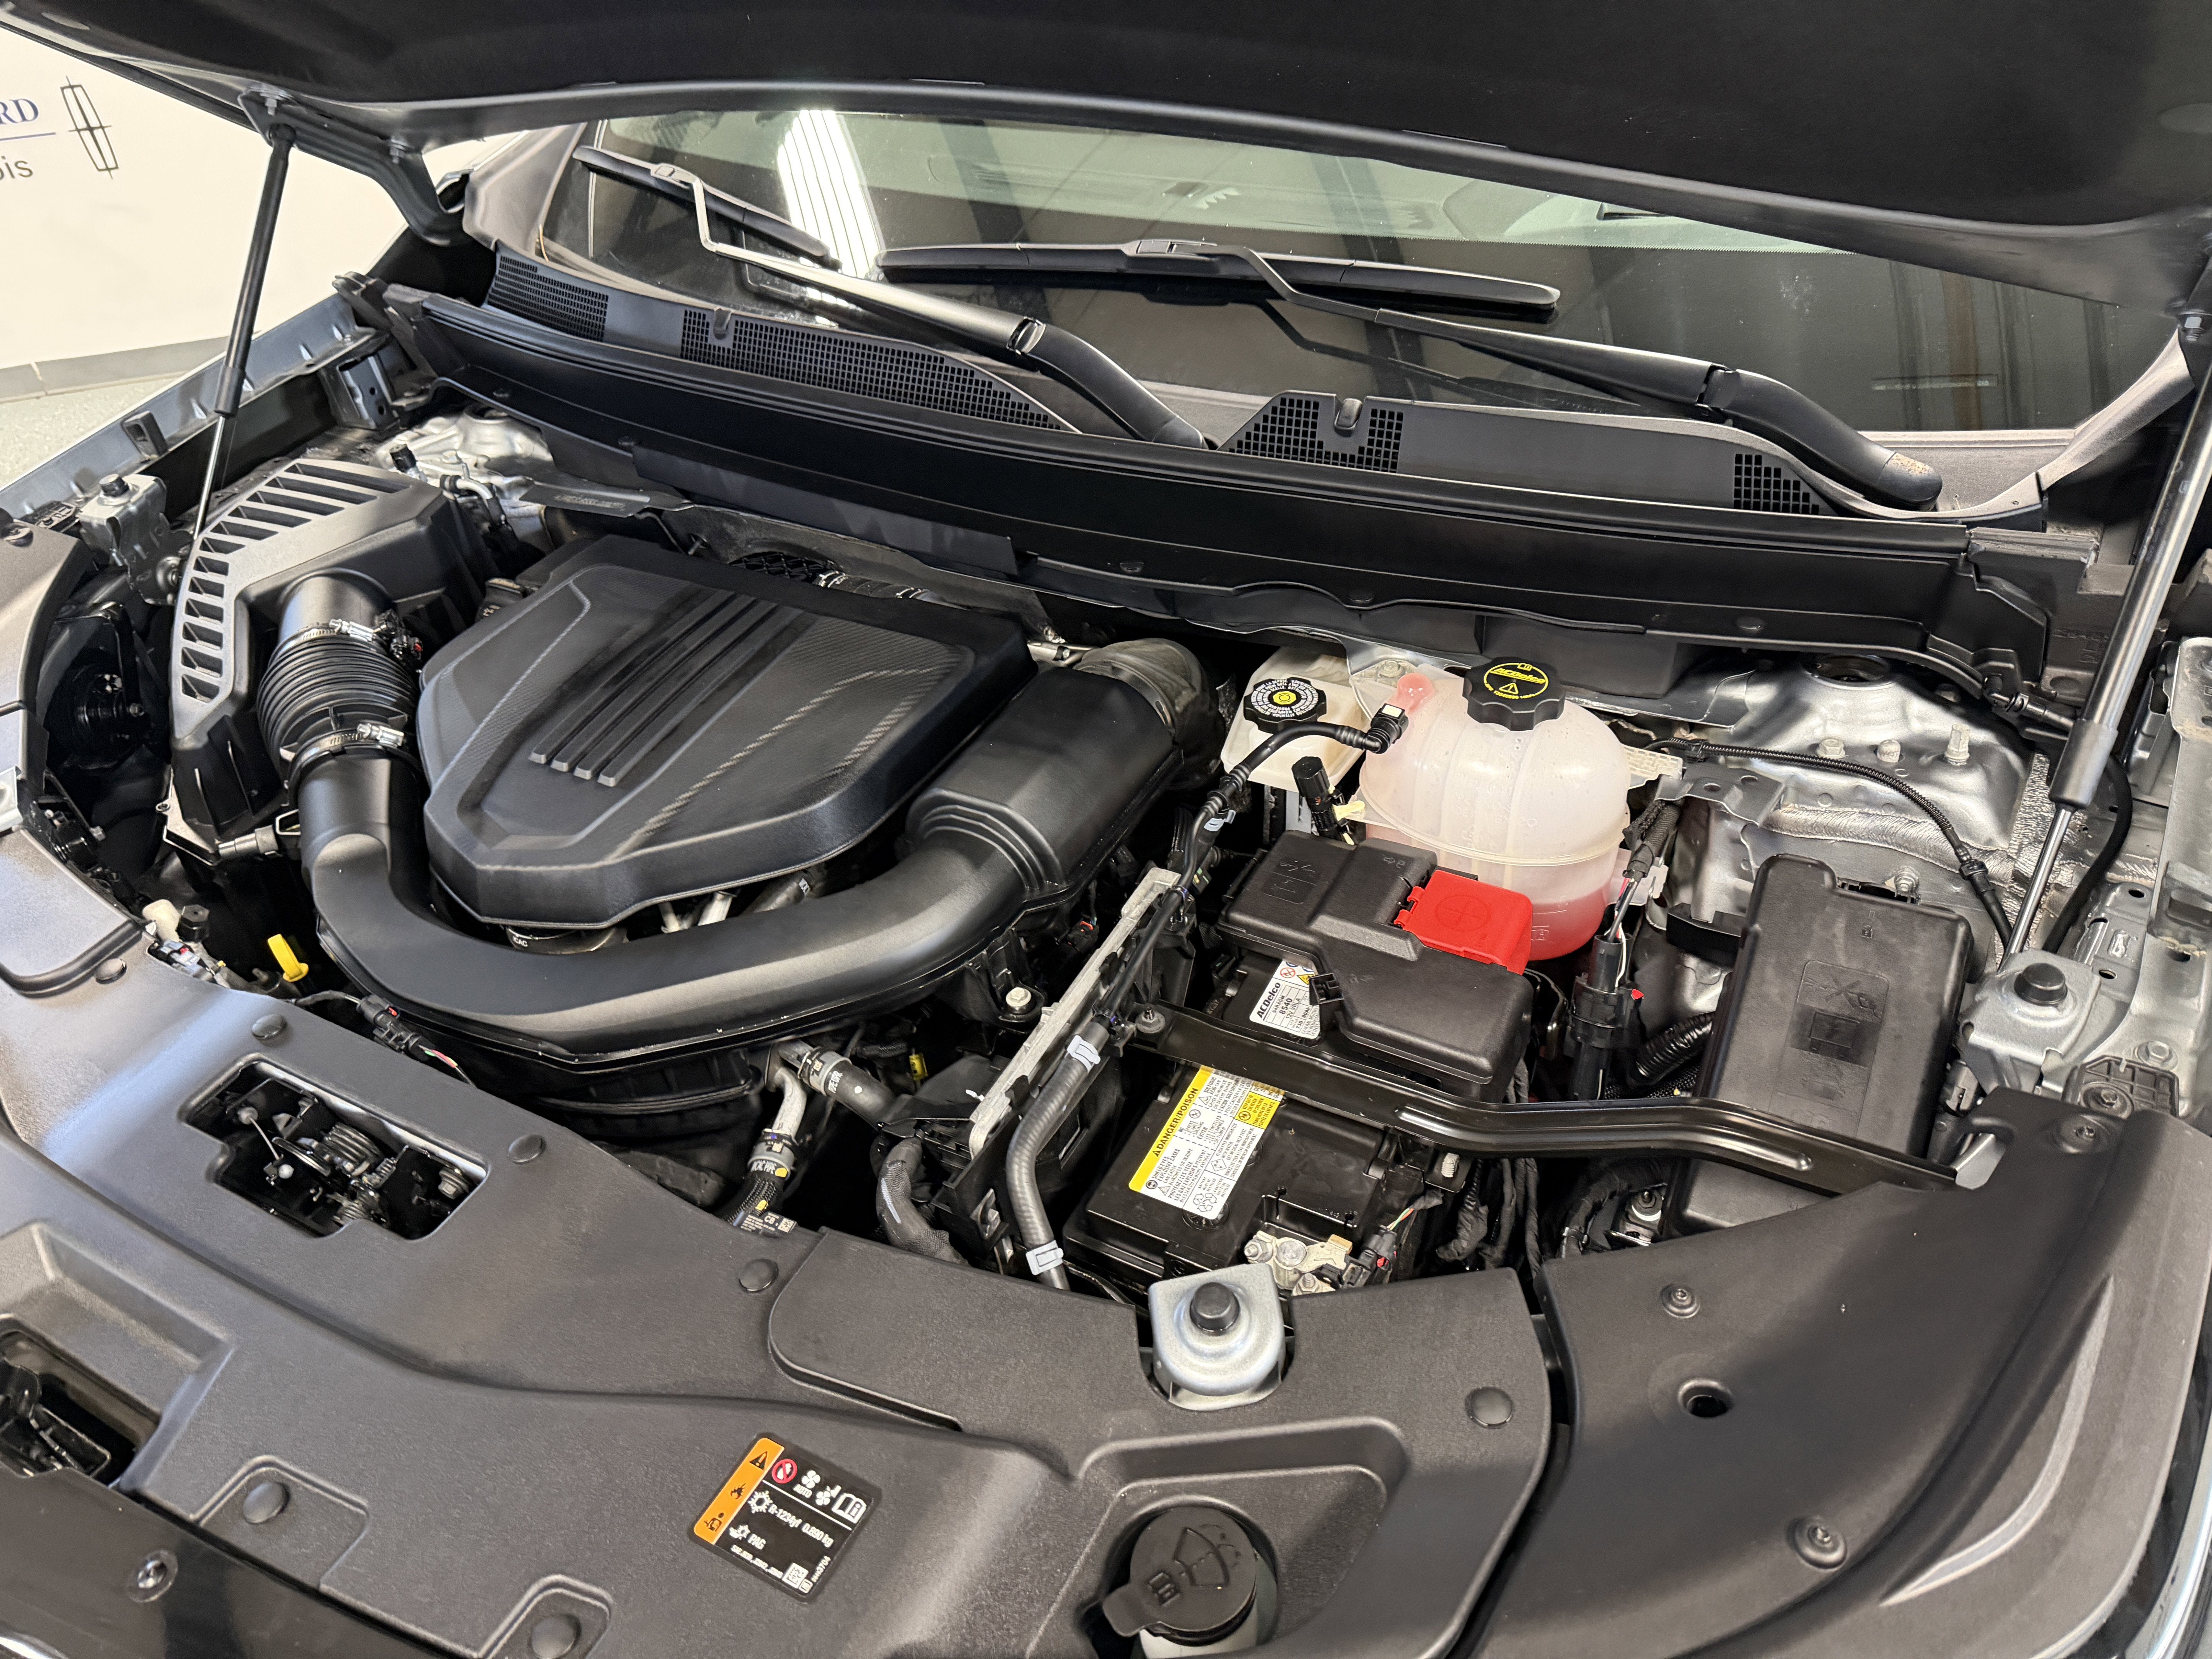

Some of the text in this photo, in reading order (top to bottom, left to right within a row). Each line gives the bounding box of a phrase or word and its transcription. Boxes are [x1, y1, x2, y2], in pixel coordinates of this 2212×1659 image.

[1493, 668, 1546, 684] ACDelco
[1257, 982, 1280, 1018] ACDelco
[1279, 998, 1293, 1014] 8540
[1285, 1010, 1295, 1020] 12V
[1156, 1088, 1198, 1149] DANGER/POISON
[793, 1484, 812, 1498] AUTO
[768, 1504, 834, 1547] R-1234yf 0.890 kg
[748, 1534, 766, 1549] PAG
